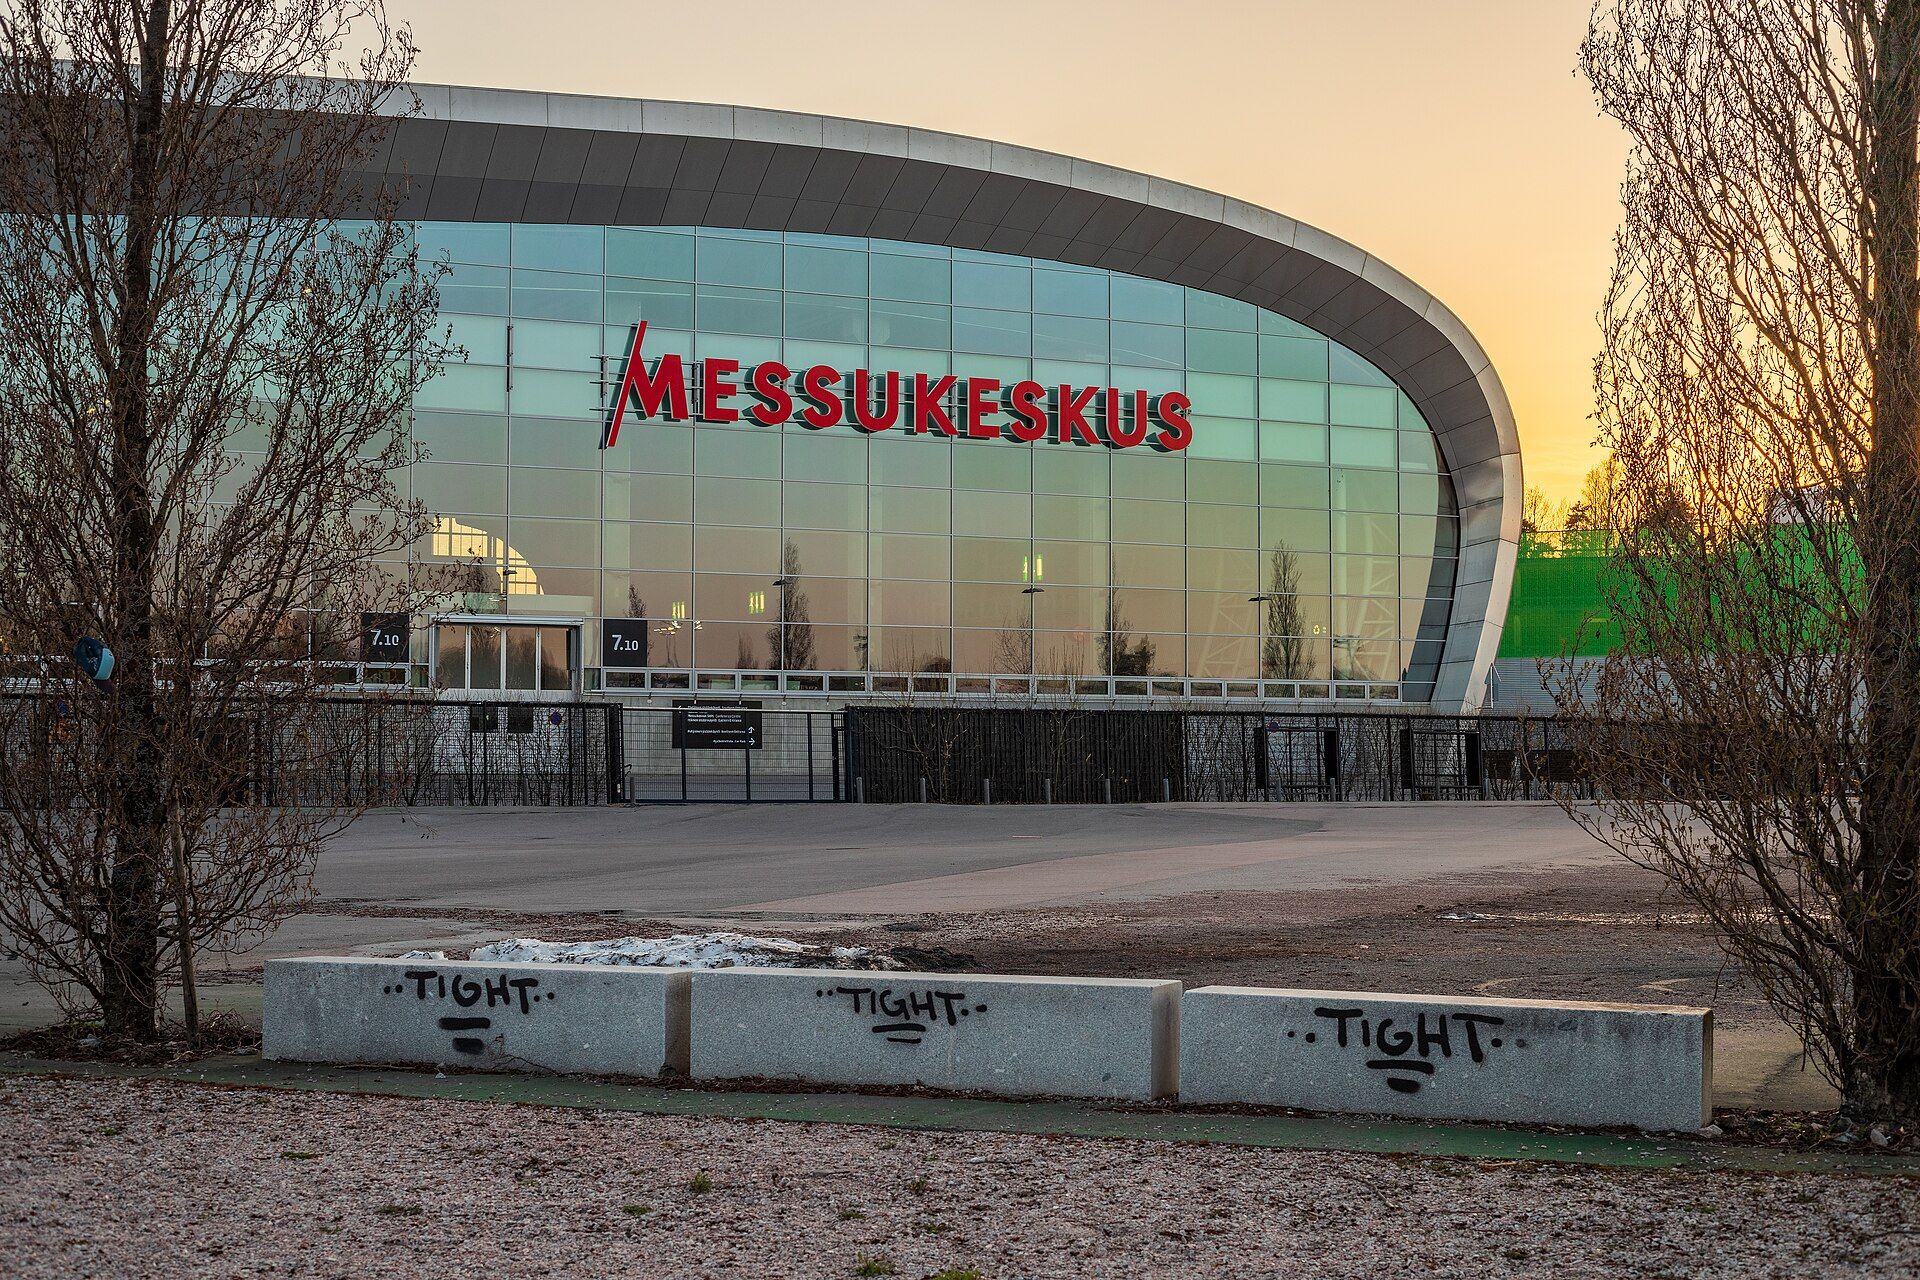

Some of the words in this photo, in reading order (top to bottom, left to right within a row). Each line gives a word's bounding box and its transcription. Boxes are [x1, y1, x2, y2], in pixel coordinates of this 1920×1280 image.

[607, 320, 1194, 452] MESSUKESKUS
[371, 629, 399, 646] 7.10
[612, 634, 639, 651] 7.10
